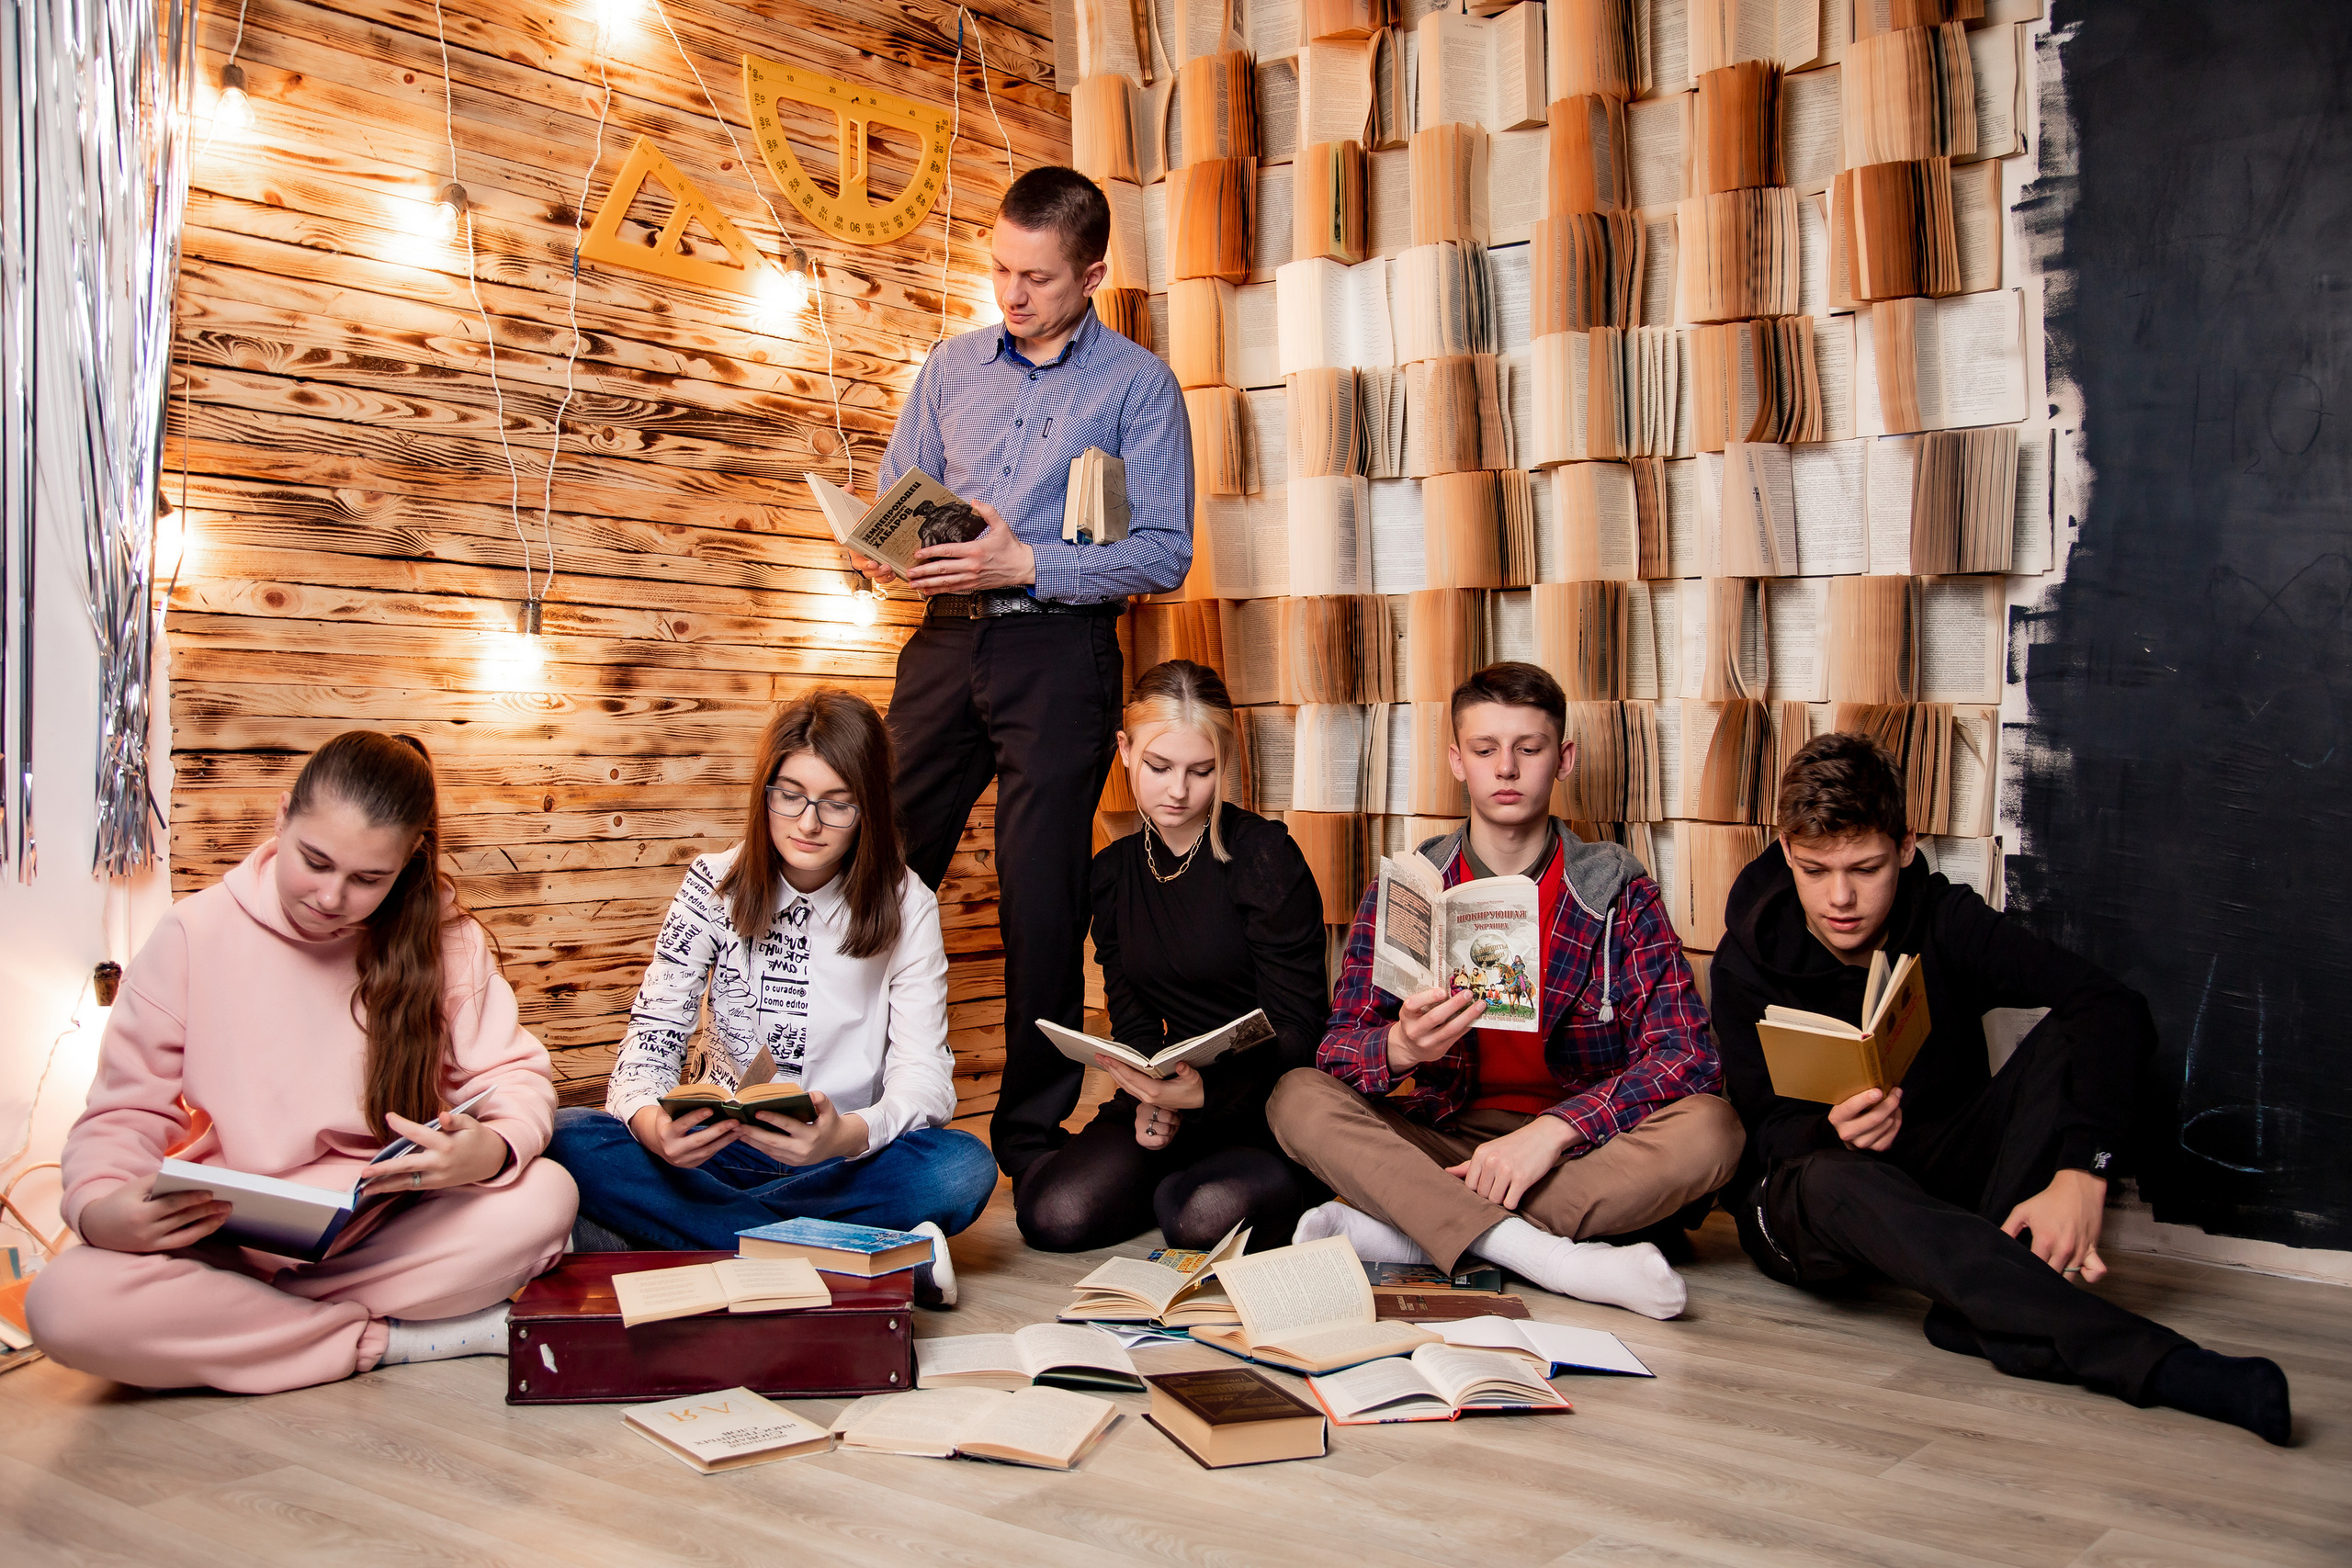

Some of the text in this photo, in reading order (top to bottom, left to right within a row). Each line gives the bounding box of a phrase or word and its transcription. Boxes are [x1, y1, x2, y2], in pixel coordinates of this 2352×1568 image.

[761, 96, 765, 104] 10
[765, 118, 771, 127] 20
[772, 140, 778, 149] 30
[782, 160, 787, 168] 40
[793, 178, 800, 186] 50
[807, 194, 813, 202] 60
[905, 205, 913, 214] 130
[915, 193, 923, 202] 140
[776, 162, 785, 174] 140
[788, 181, 797, 193] 130
[803, 197, 811, 209] 120
[819, 211, 827, 220] 110
[834, 221, 843, 230] 100
[850, 222, 860, 232] 90
[929, 183, 934, 191] 30
[935, 164, 940, 173] 20
[678, 183, 684, 191] 10
[698, 203, 704, 211] 15
[717, 222, 724, 231] 20
[736, 242, 743, 251] 25
[755, 261, 762, 269] 30
[862, 481, 922, 543] ЗЕМЛЕПРОХОДЕЦ
[872, 507, 913, 549] ХАБАРОВ
[688, 896, 707, 912] editor
[1457, 910, 1526, 923] ШОКИРУЮЩАЯ
[1474, 922, 1509, 931] УКРАИНА
[773, 986, 800, 995] curador
[763, 997, 808, 1010] como editor
[694, 1423, 797, 1446] ИНОСТРАННЫХ
[722, 1426, 758, 1436] СЛОВ
[722, 1429, 783, 1446] СЛОВАРЬ
